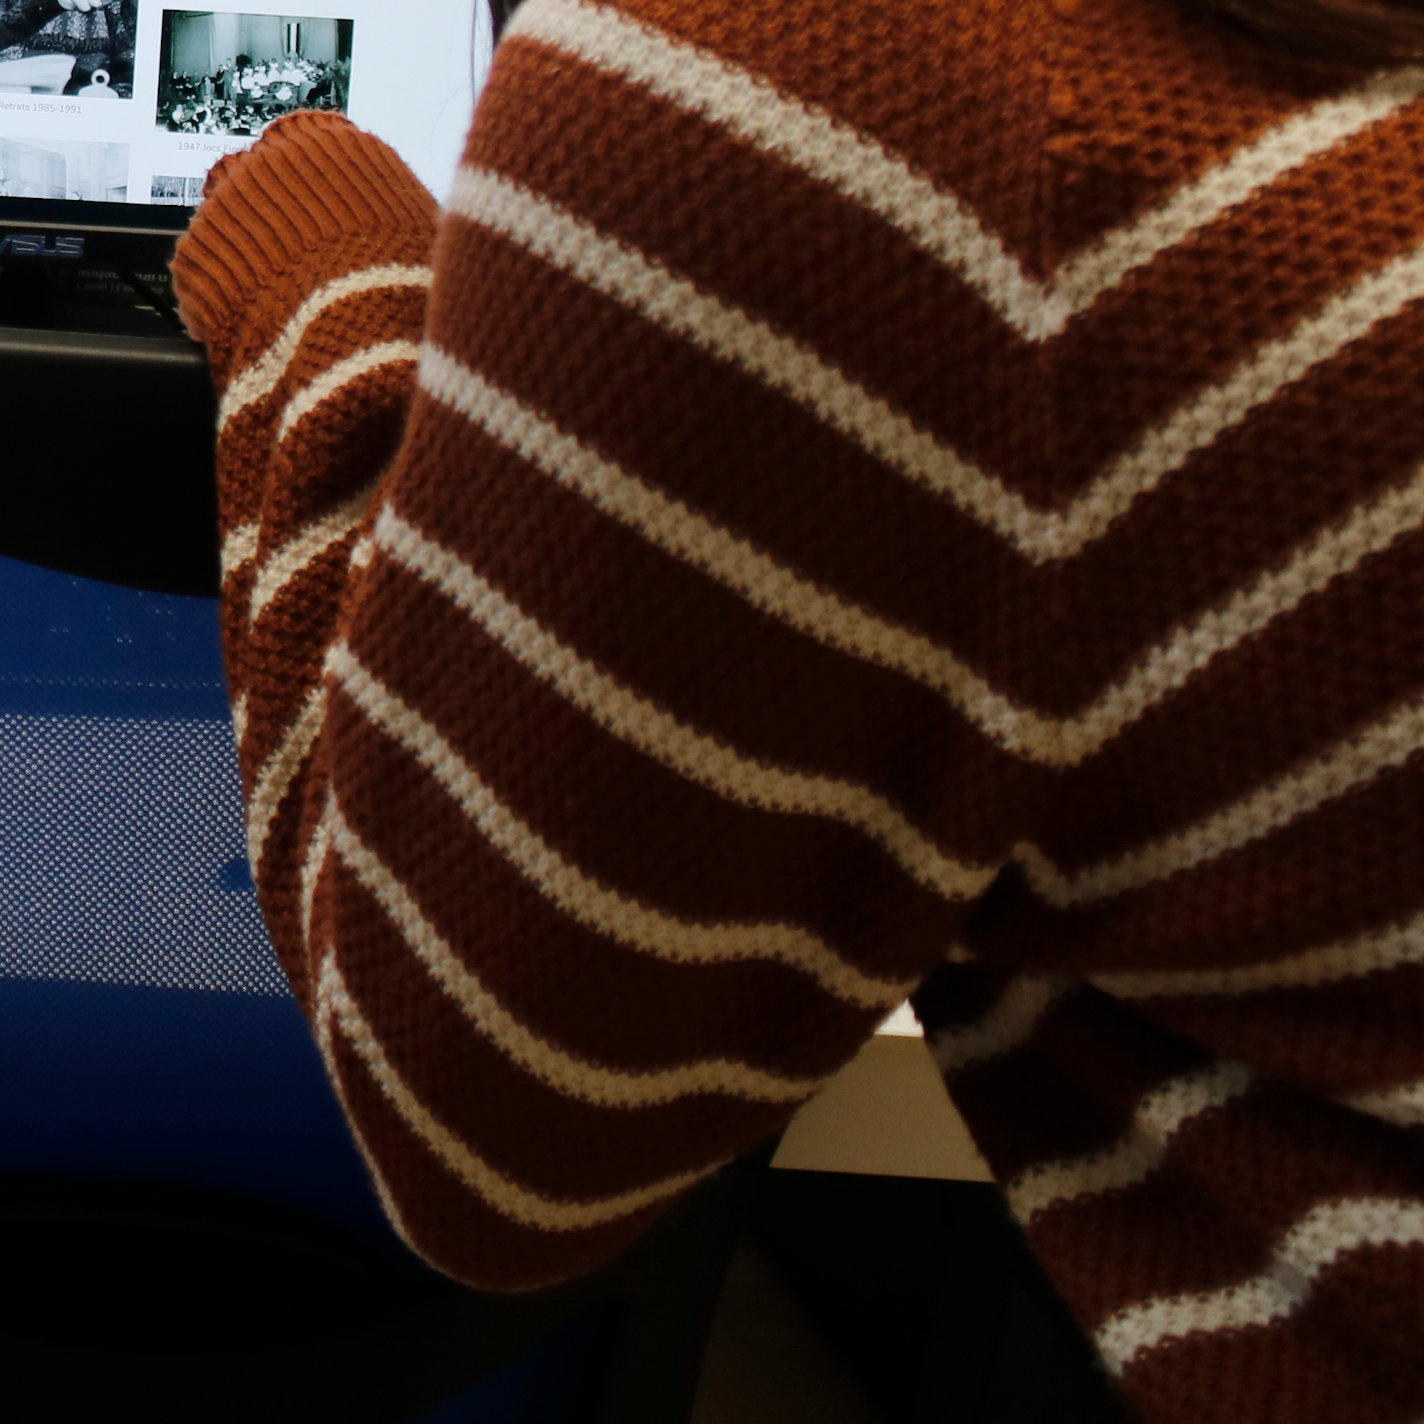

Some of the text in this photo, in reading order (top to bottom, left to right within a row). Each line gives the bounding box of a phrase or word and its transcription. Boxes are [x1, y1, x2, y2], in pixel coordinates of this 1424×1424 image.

[32, 103, 82, 114] 1985-1991
[177, 142, 201, 151] 1947
[202, 143, 222, 153] Jocs
